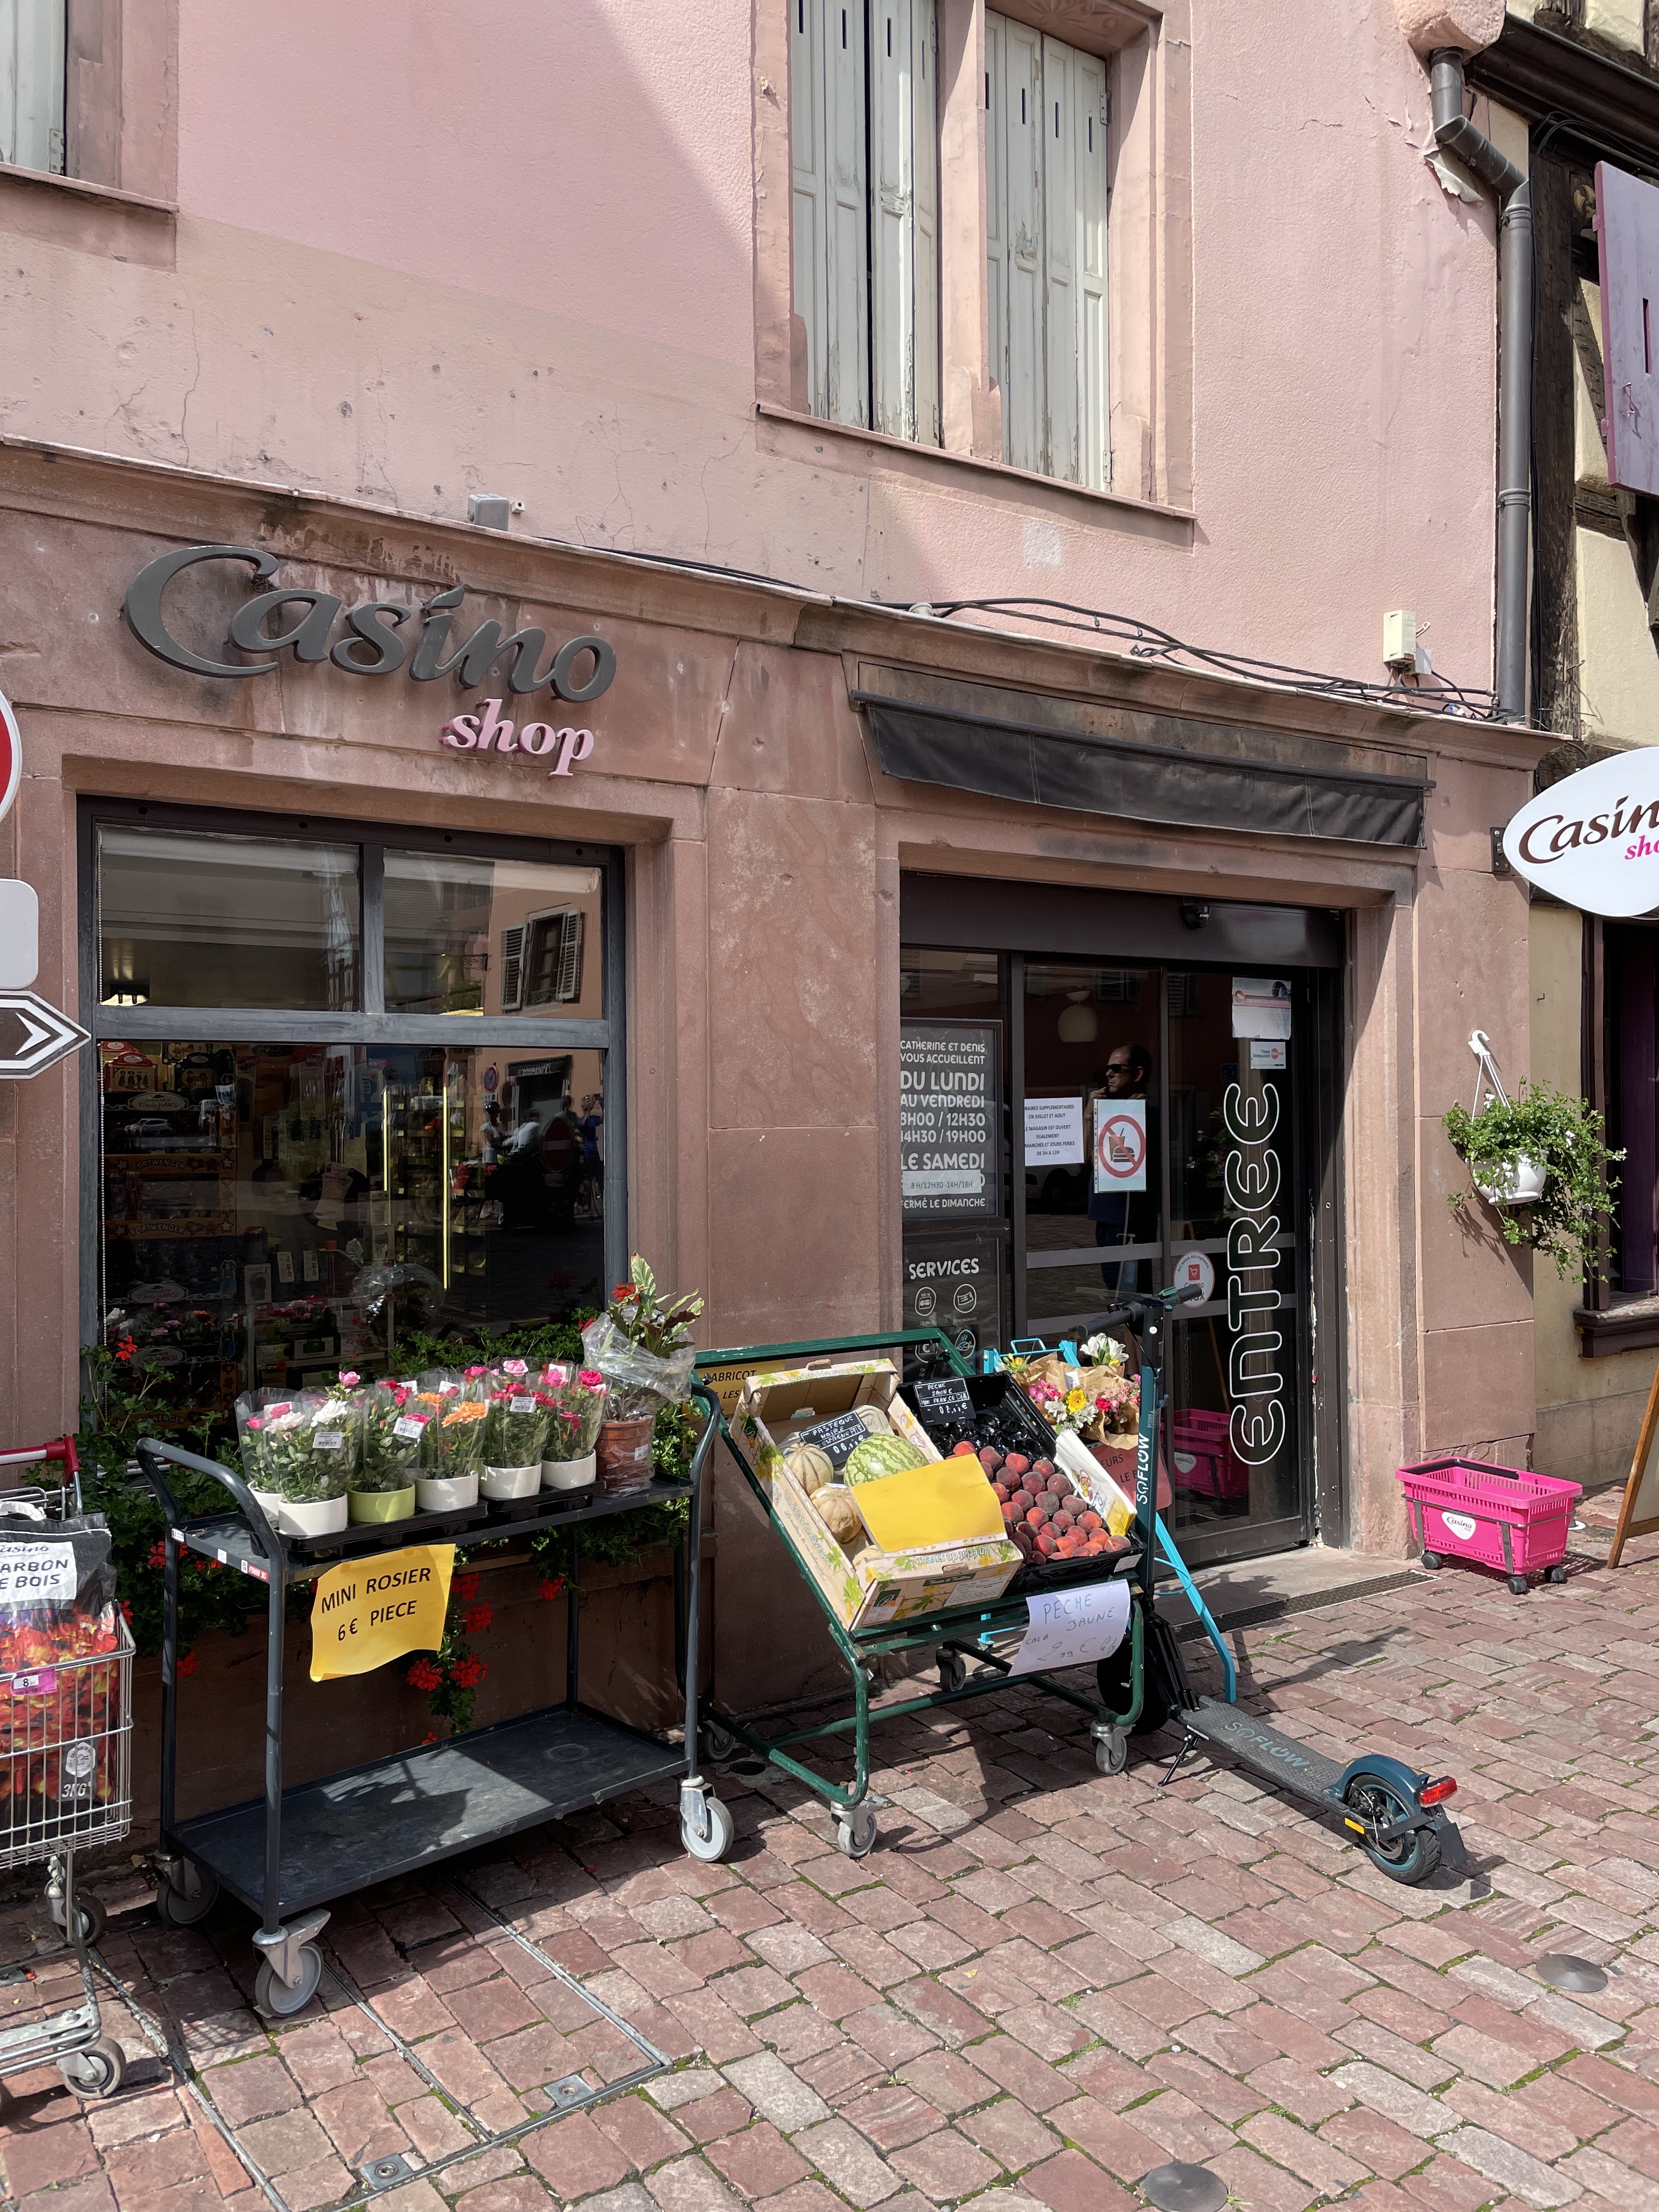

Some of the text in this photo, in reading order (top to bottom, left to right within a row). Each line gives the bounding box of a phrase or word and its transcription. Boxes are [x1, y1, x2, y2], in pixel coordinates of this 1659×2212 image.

[122, 545, 617, 703] Casino
[441, 698, 595, 779] shop
[900, 1040, 985, 1052] CATHERINE ET DENIS
[900, 1053, 985, 1064] VOUS ACCUEILLENT
[900, 1071, 985, 1091] DU LUNDI
[900, 1094, 985, 1108] AU VENDREDI
[900, 1112, 935, 1126] 8H00
[946, 1113, 986, 1126] 12H30
[901, 1130, 936, 1143] 14H30
[946, 1130, 986, 1143] 19H00
[901, 1153, 985, 1170] LE SAMEDI
[930, 1199, 940, 1208] LE
[942, 1198, 986, 1207] DIMANCHE
[909, 1257, 979, 1280] SERVICES
[712, 1370, 757, 1382] ABRICOT
[723, 1390, 740, 1399] LES
[812, 1415, 854, 1436] PASTEQUE
[1137, 1432, 1149, 1504] SOFLOW
[1120, 1472, 1131, 1483] LE
[1447, 1516, 1472, 1528] Casino
[0, 1559, 69, 1573] ARBON
[15, 1573, 61, 1588] BOIS
[321, 1567, 431, 1614] MINI ROSIER
[370, 1600, 417, 1627] PIECE
[1043, 1594, 1093, 1624] PECHE
[1066, 1607, 1115, 1632] JAUNE
[1224, 1720, 1311, 1769] SOFLOW
